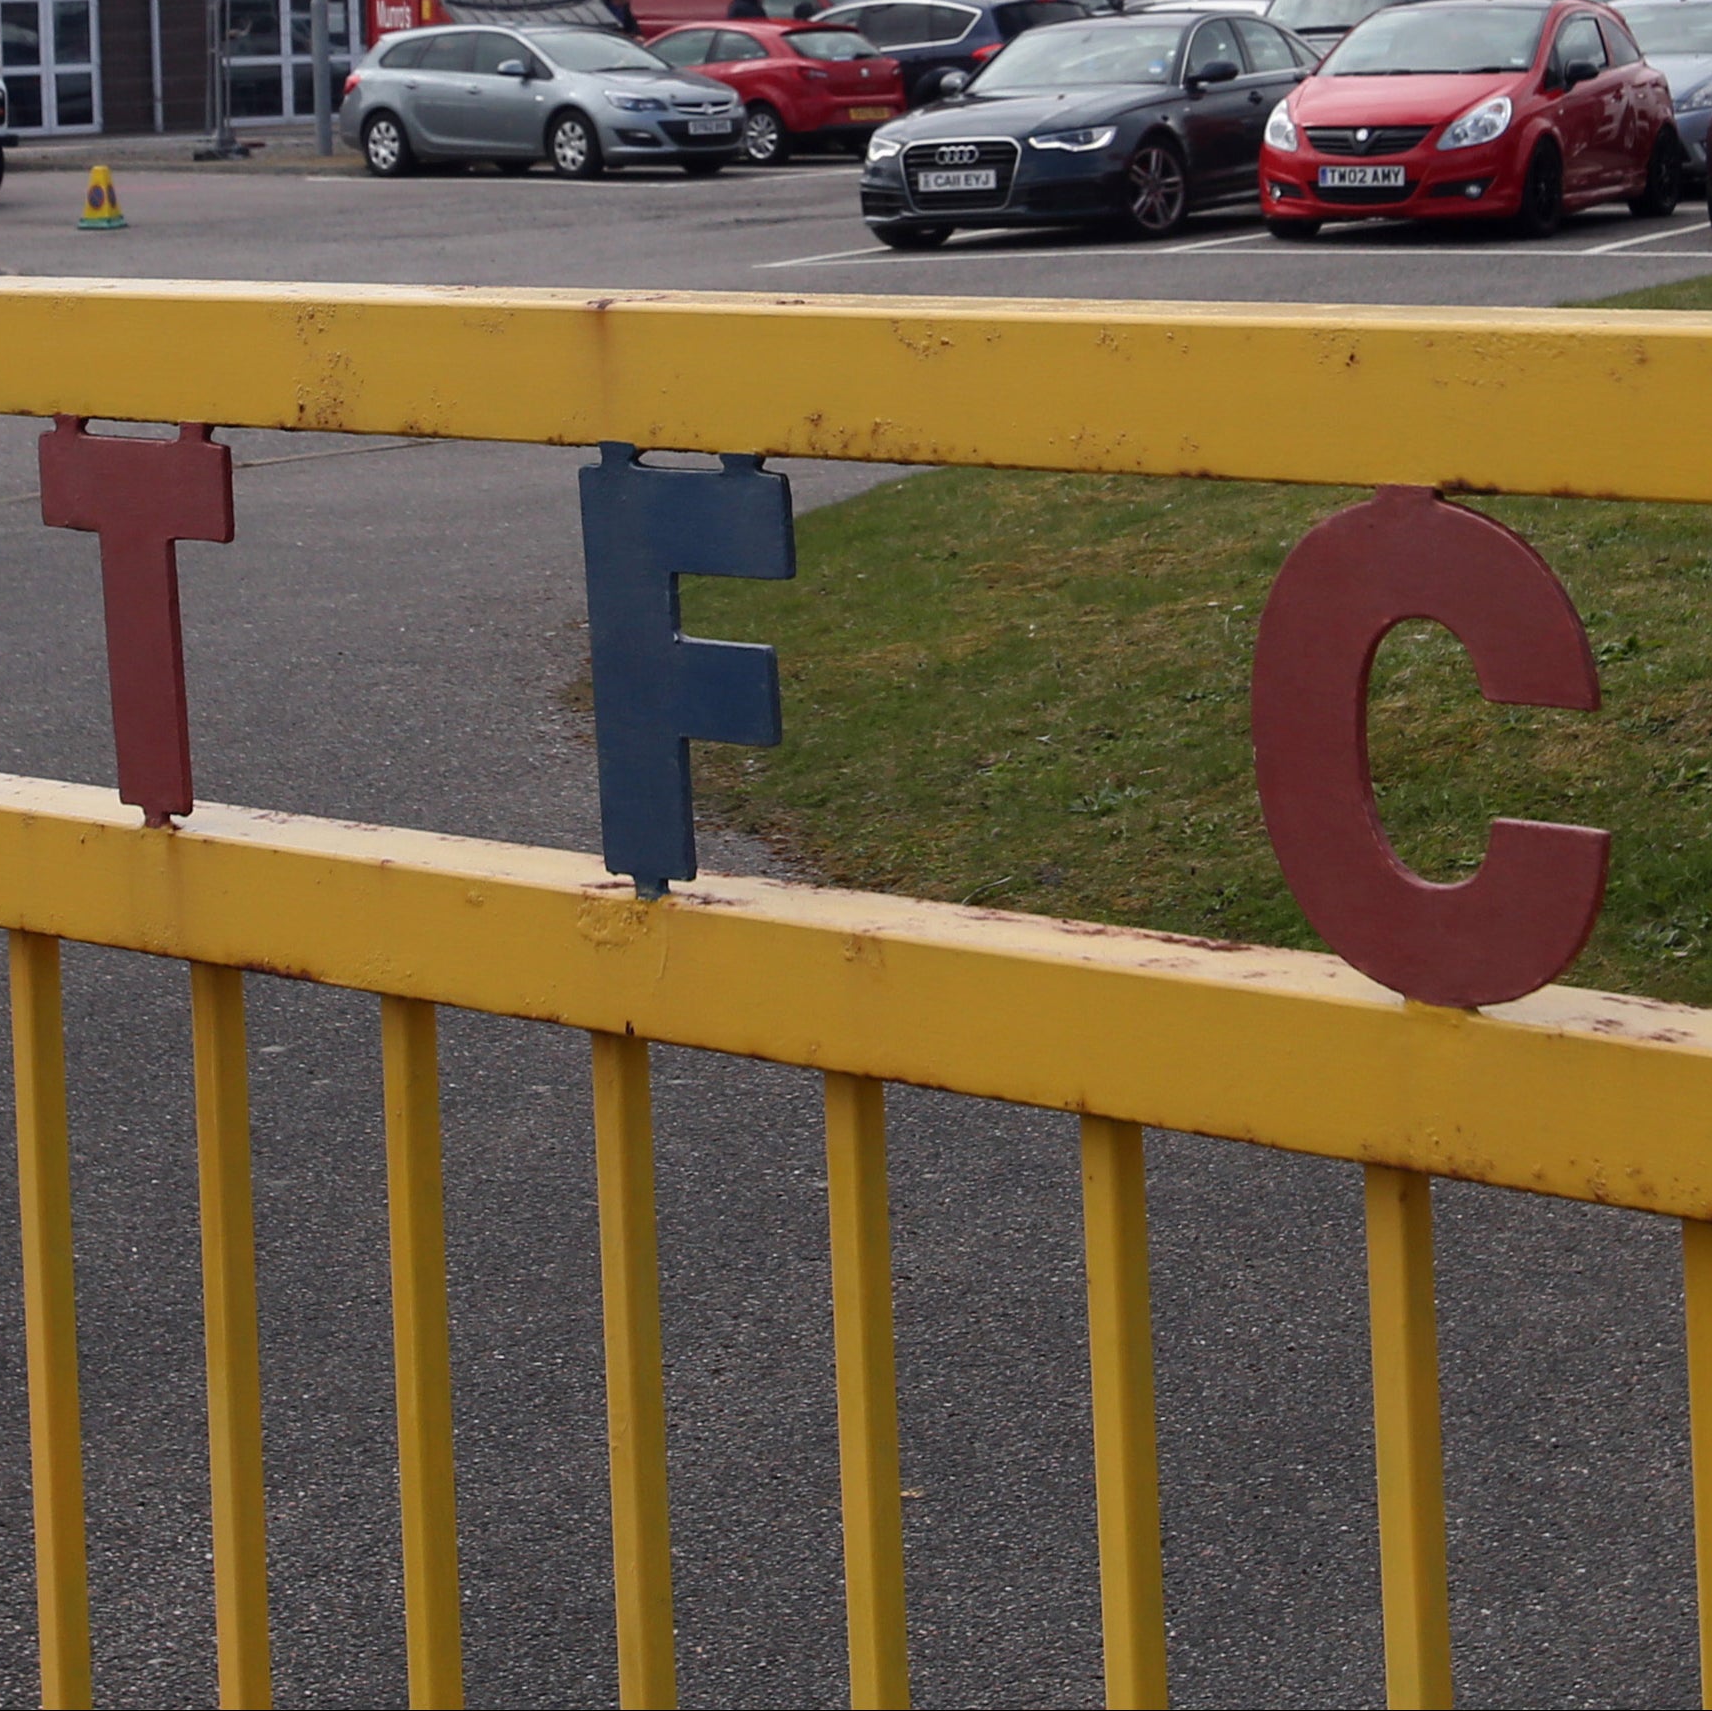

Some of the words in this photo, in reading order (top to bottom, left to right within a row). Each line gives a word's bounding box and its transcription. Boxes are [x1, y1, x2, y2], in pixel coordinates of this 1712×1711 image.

[375, 0, 412, 28] Munro's
[964, 173, 989, 185] EYJ
[1329, 169, 1367, 184] TW02
[1371, 169, 1401, 184] AMY
